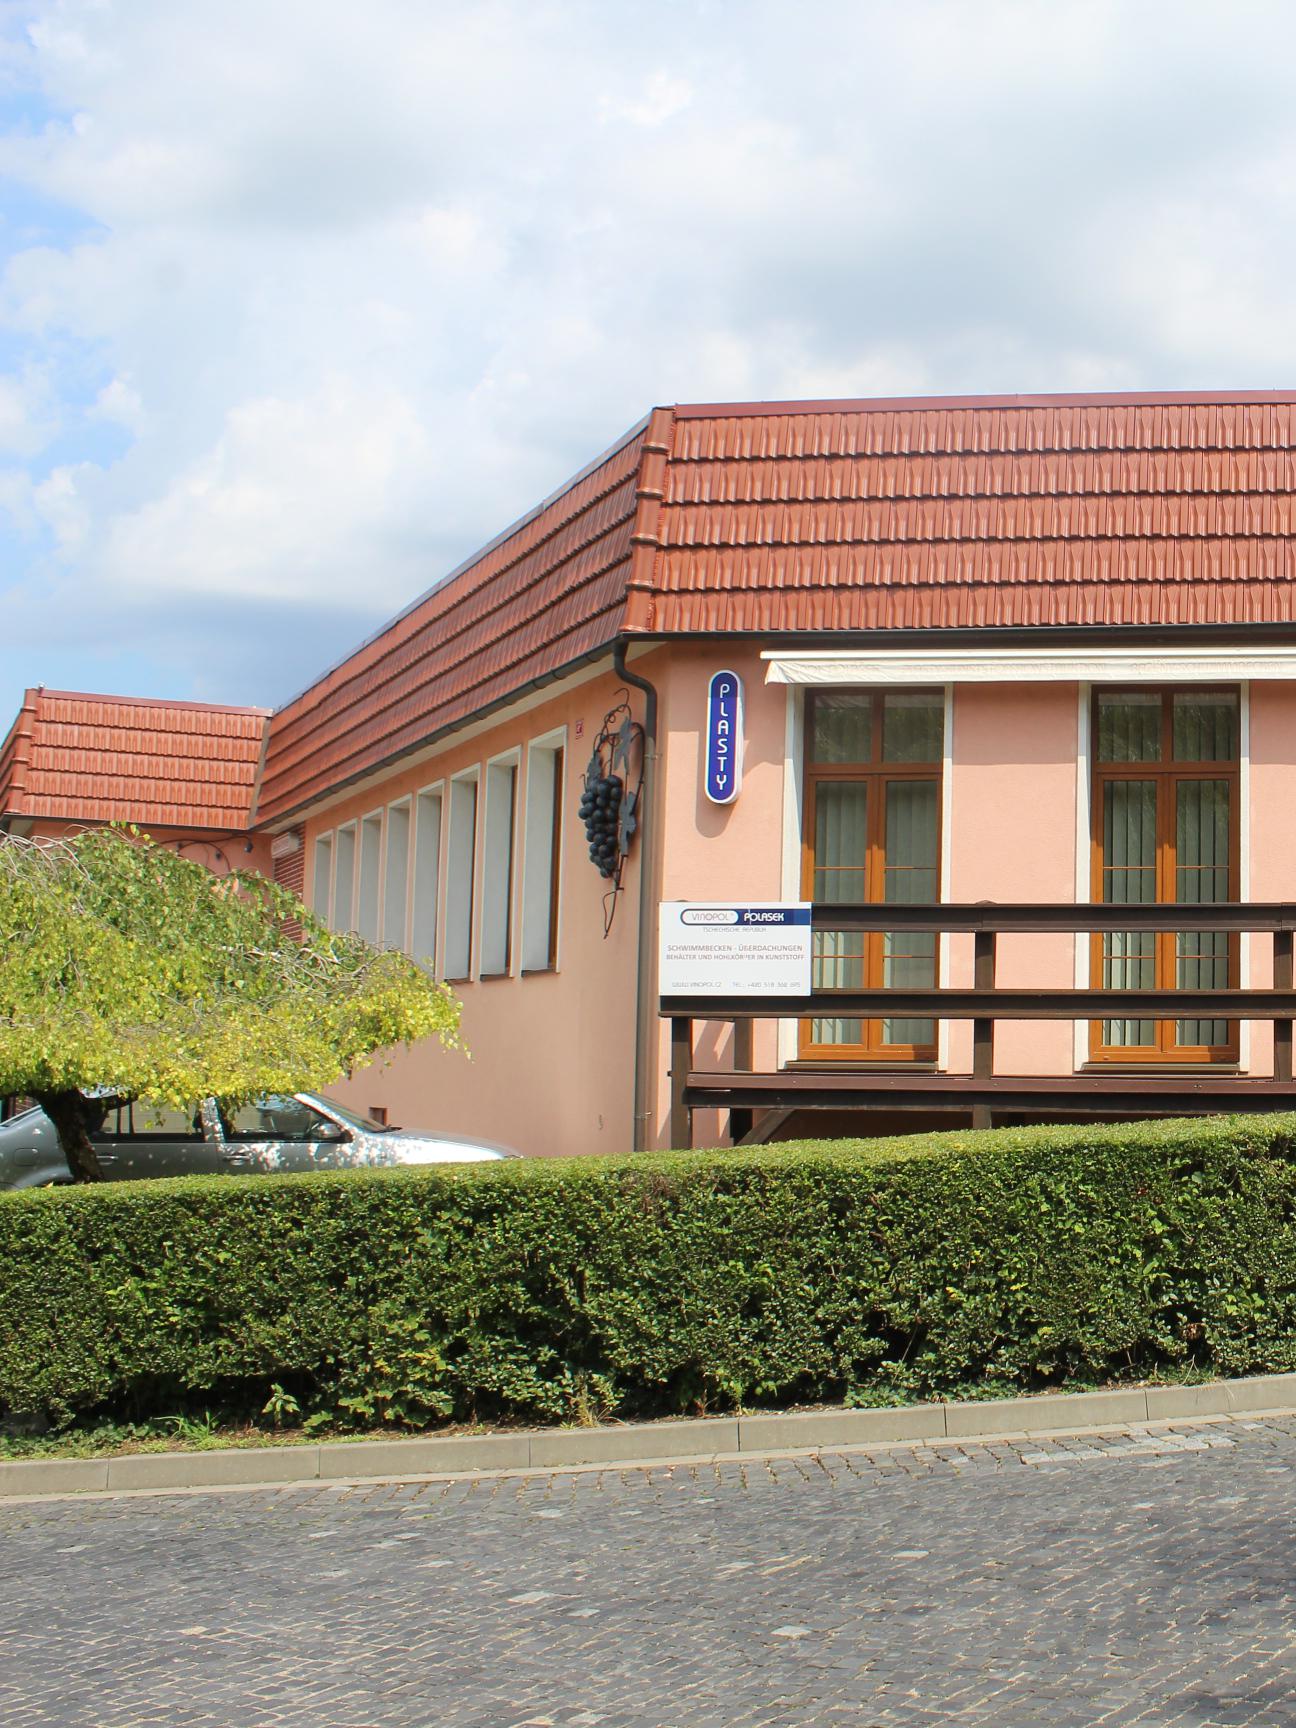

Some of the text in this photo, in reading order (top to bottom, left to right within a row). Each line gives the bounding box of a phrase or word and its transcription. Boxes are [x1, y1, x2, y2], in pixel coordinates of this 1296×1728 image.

[716, 683, 730, 791] PLASTY
[744, 912, 784, 922] POLASEK
[739, 943, 803, 951] ÜBERDACHUNGEN
